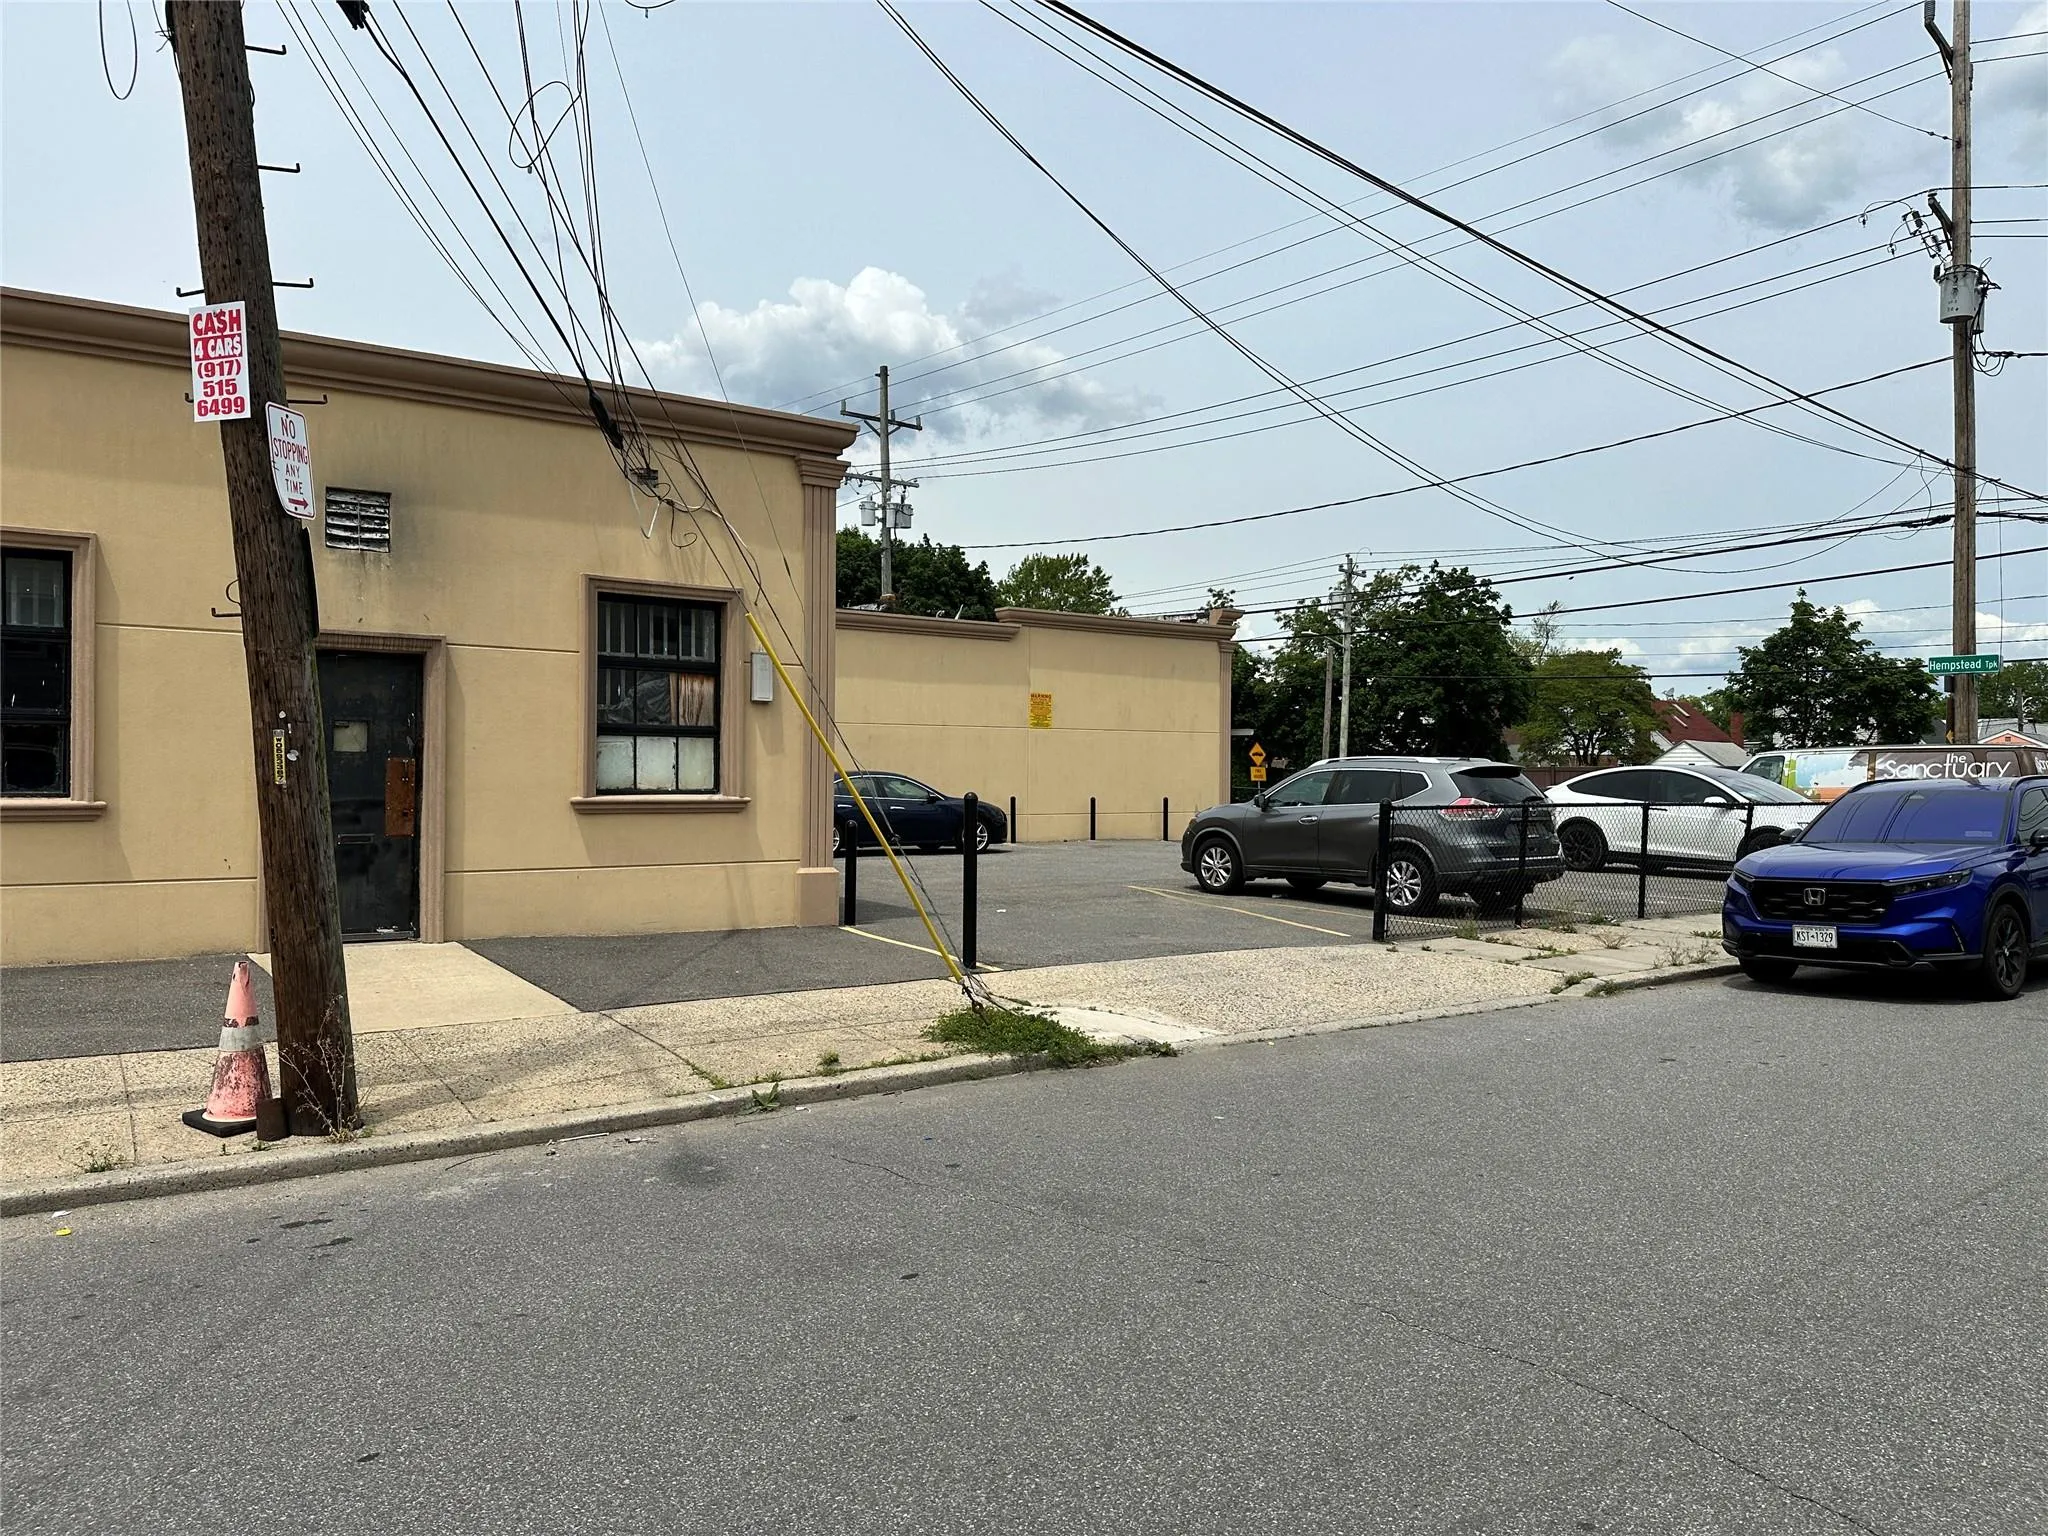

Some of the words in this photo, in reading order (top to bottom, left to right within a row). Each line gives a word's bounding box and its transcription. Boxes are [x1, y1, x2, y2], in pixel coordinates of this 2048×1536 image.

[194, 341, 203, 359] 4
[197, 359, 241, 378] (917)
[203, 378, 237, 397] 515
[197, 396, 245, 417] 6499
[281, 416, 296, 439] NO
[273, 437, 308, 465] STOPPING
[285, 463, 300, 479] ANY
[285, 478, 303, 495] TIME
[1929, 659, 1982, 671] Hempstead
[1985, 660, 1998, 670] Tpk
[1884, 757, 2012, 778] Sanctuary
[1946, 753, 1967, 764] the
